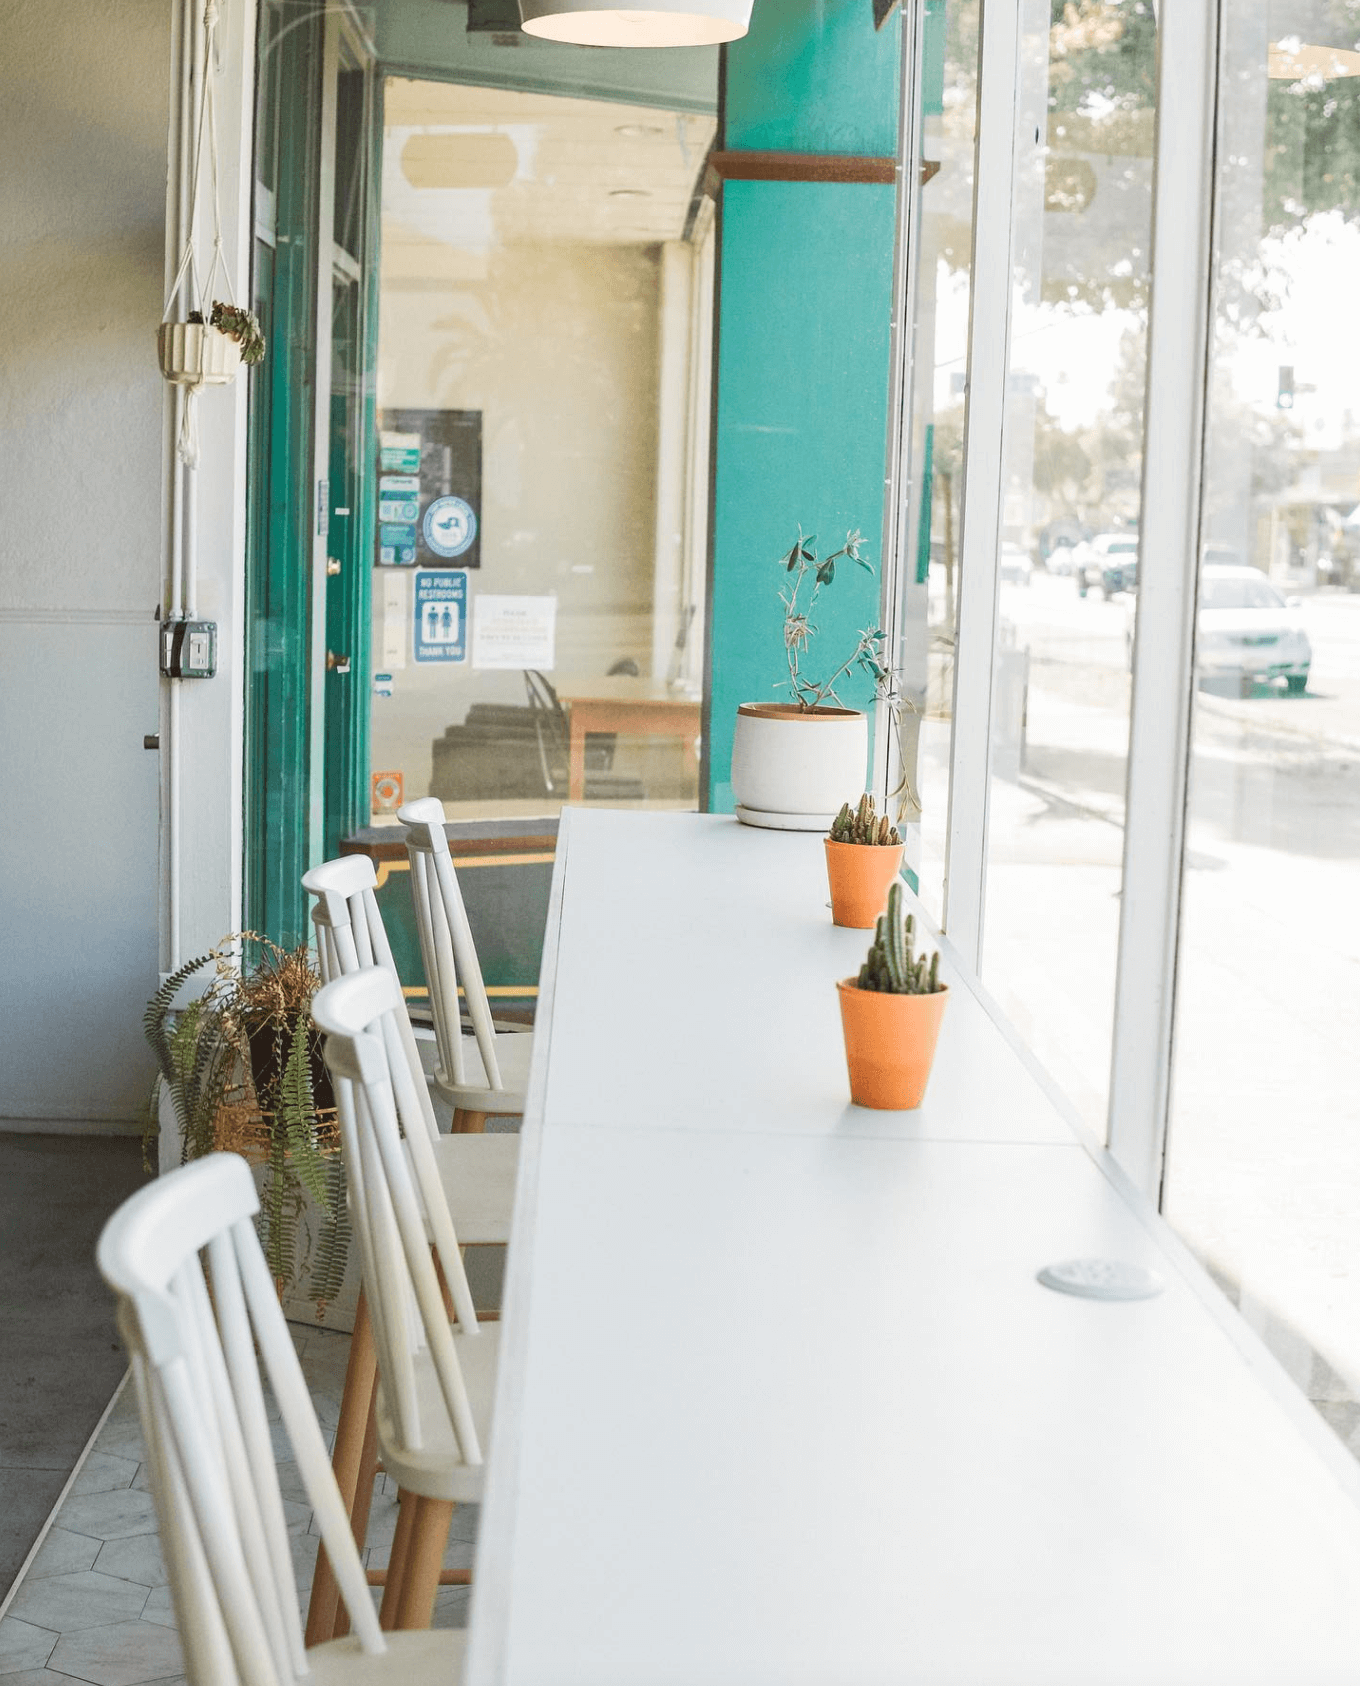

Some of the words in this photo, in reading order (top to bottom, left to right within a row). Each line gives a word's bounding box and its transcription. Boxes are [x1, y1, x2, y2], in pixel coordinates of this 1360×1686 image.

[420, 577, 432, 588] NO
[434, 577, 462, 588] PUBLIC
[418, 588, 463, 600] RESTROOMS
[419, 645, 443, 657] THANK
[445, 645, 462, 657] YOU
